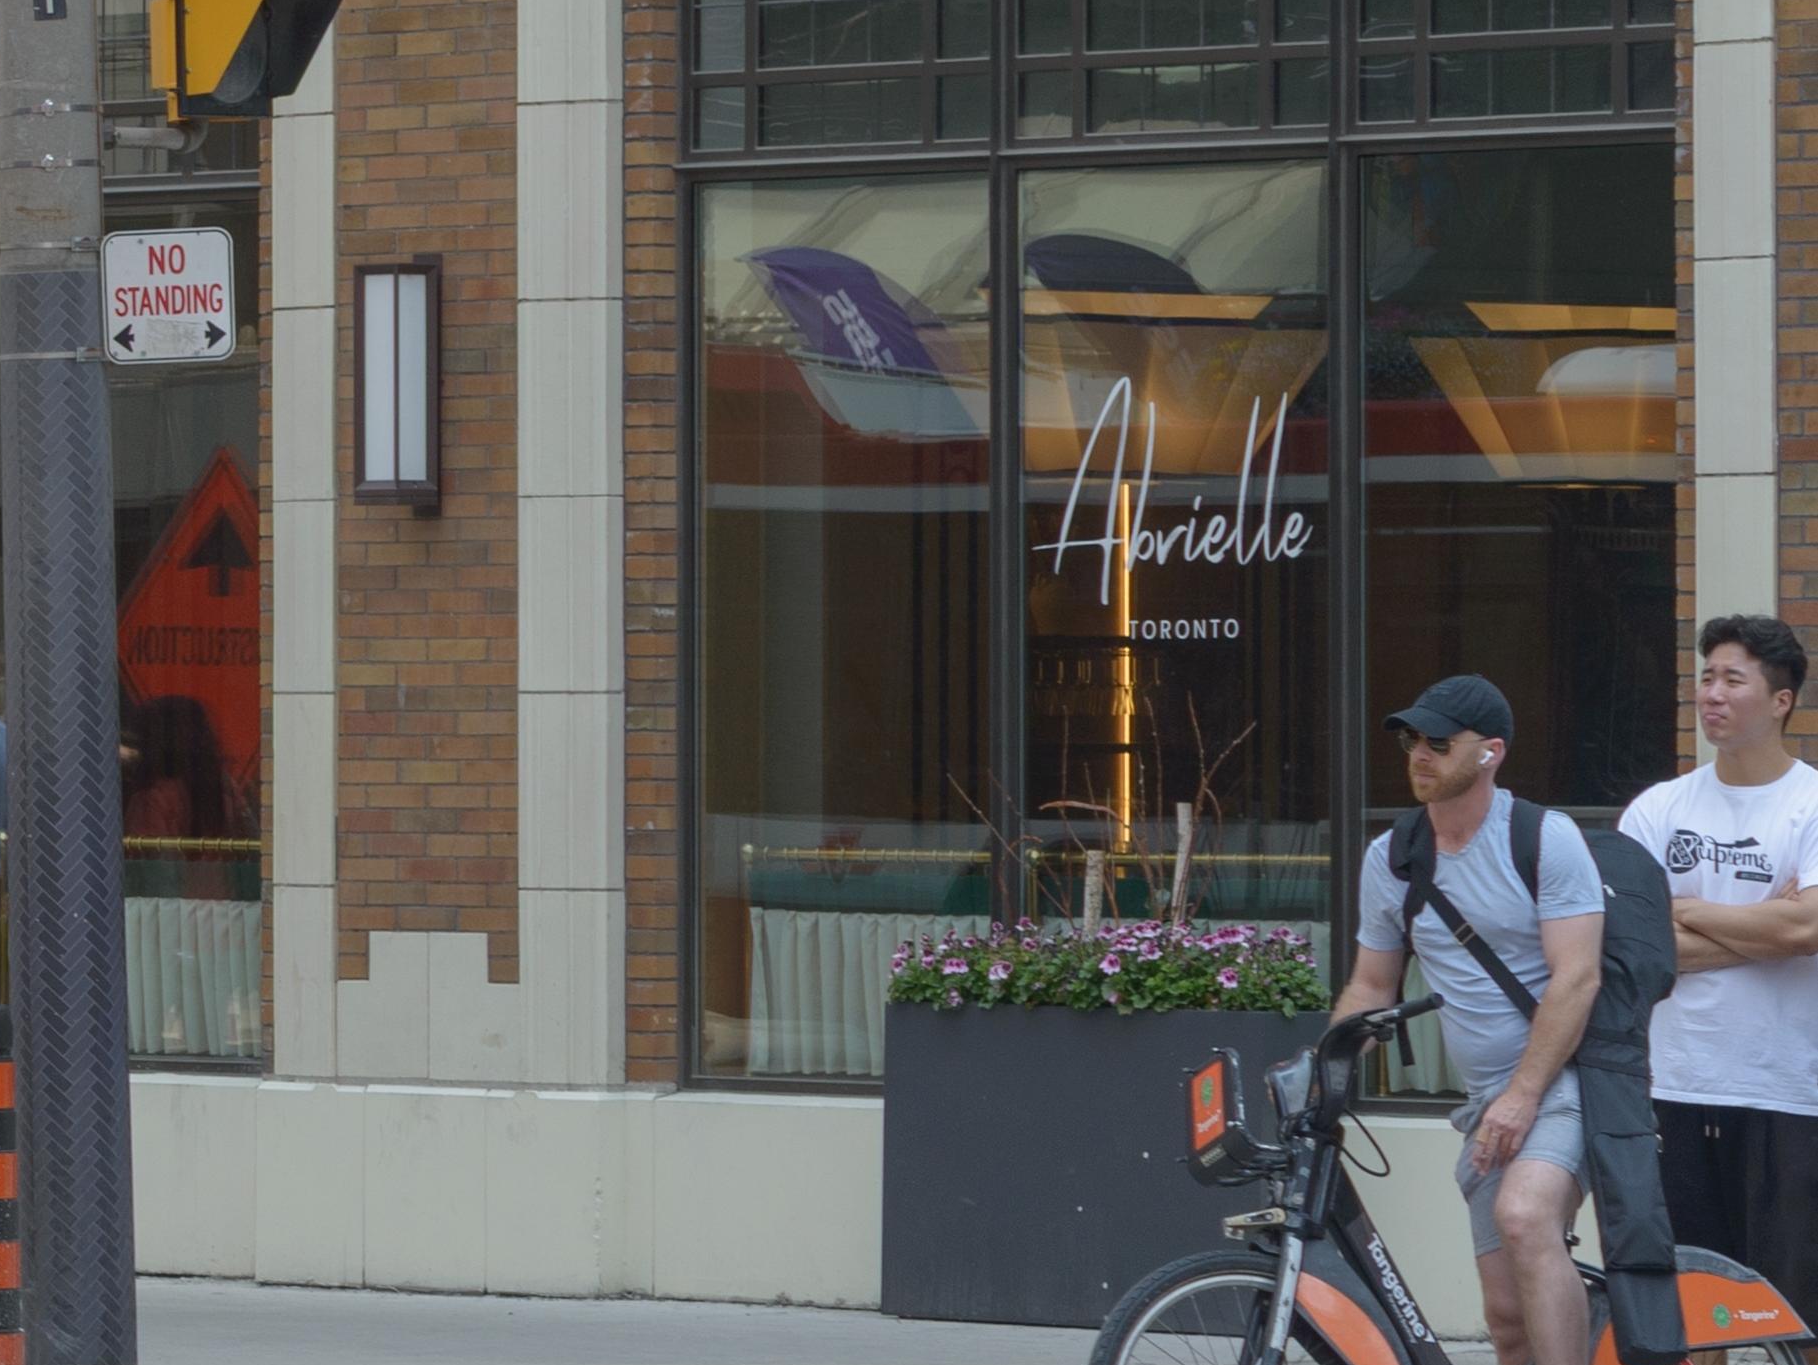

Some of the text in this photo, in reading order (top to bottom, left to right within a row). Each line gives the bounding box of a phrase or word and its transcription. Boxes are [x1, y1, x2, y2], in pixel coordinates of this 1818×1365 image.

[148, 243, 186, 276] NO
[114, 282, 224, 317] STANDING
[1032, 376, 1315, 606] Abrielle
[1128, 617, 1241, 640] TORONTO
[1367, 1232, 1427, 1340] Tangerine
